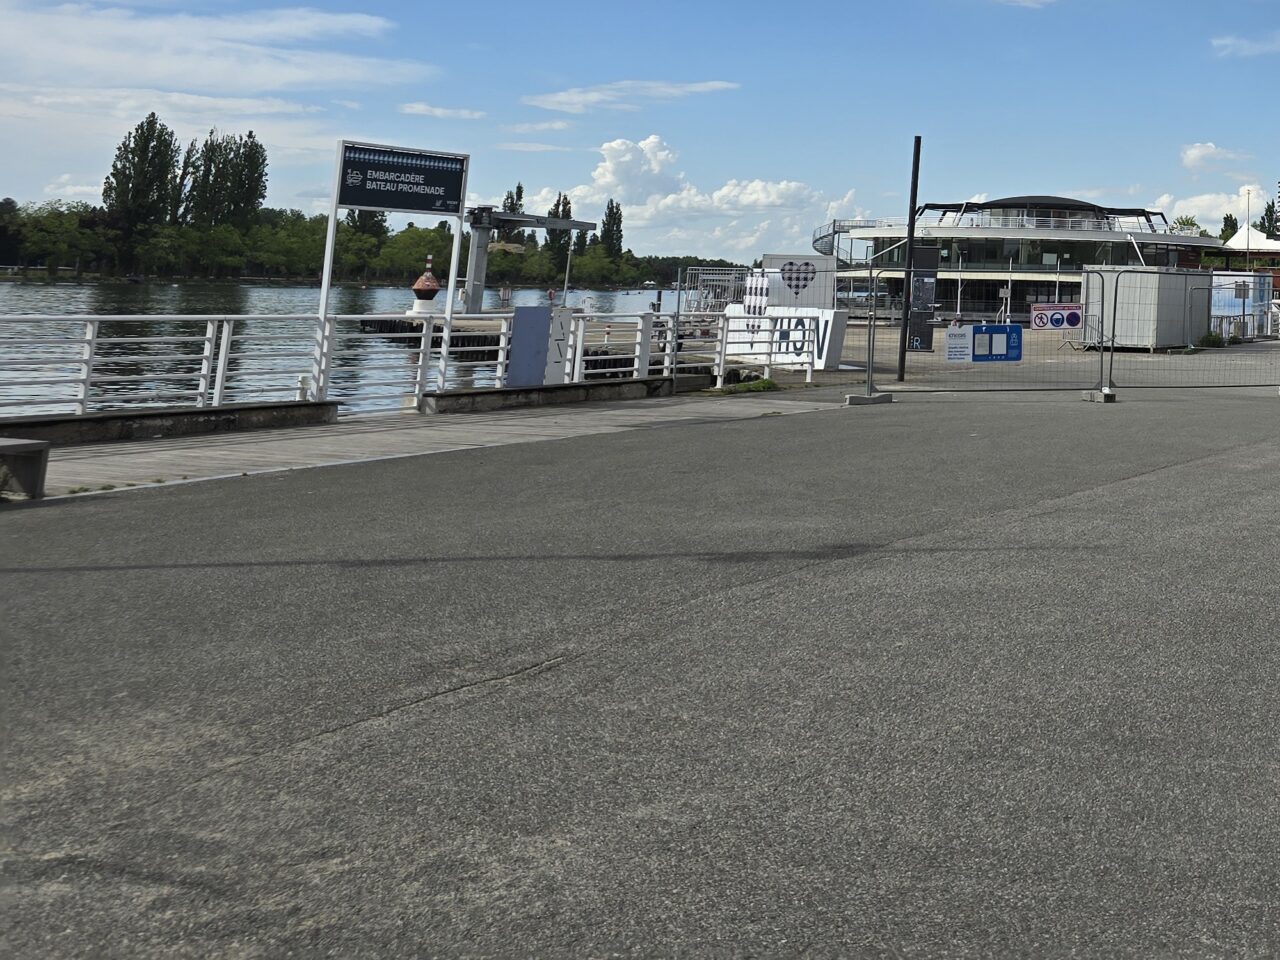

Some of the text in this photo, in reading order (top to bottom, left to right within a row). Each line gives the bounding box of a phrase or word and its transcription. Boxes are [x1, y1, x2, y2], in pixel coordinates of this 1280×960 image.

[367, 170, 425, 183] EMBARCADÈRE
[366, 181, 445, 195] BATEAU PROMENADE
